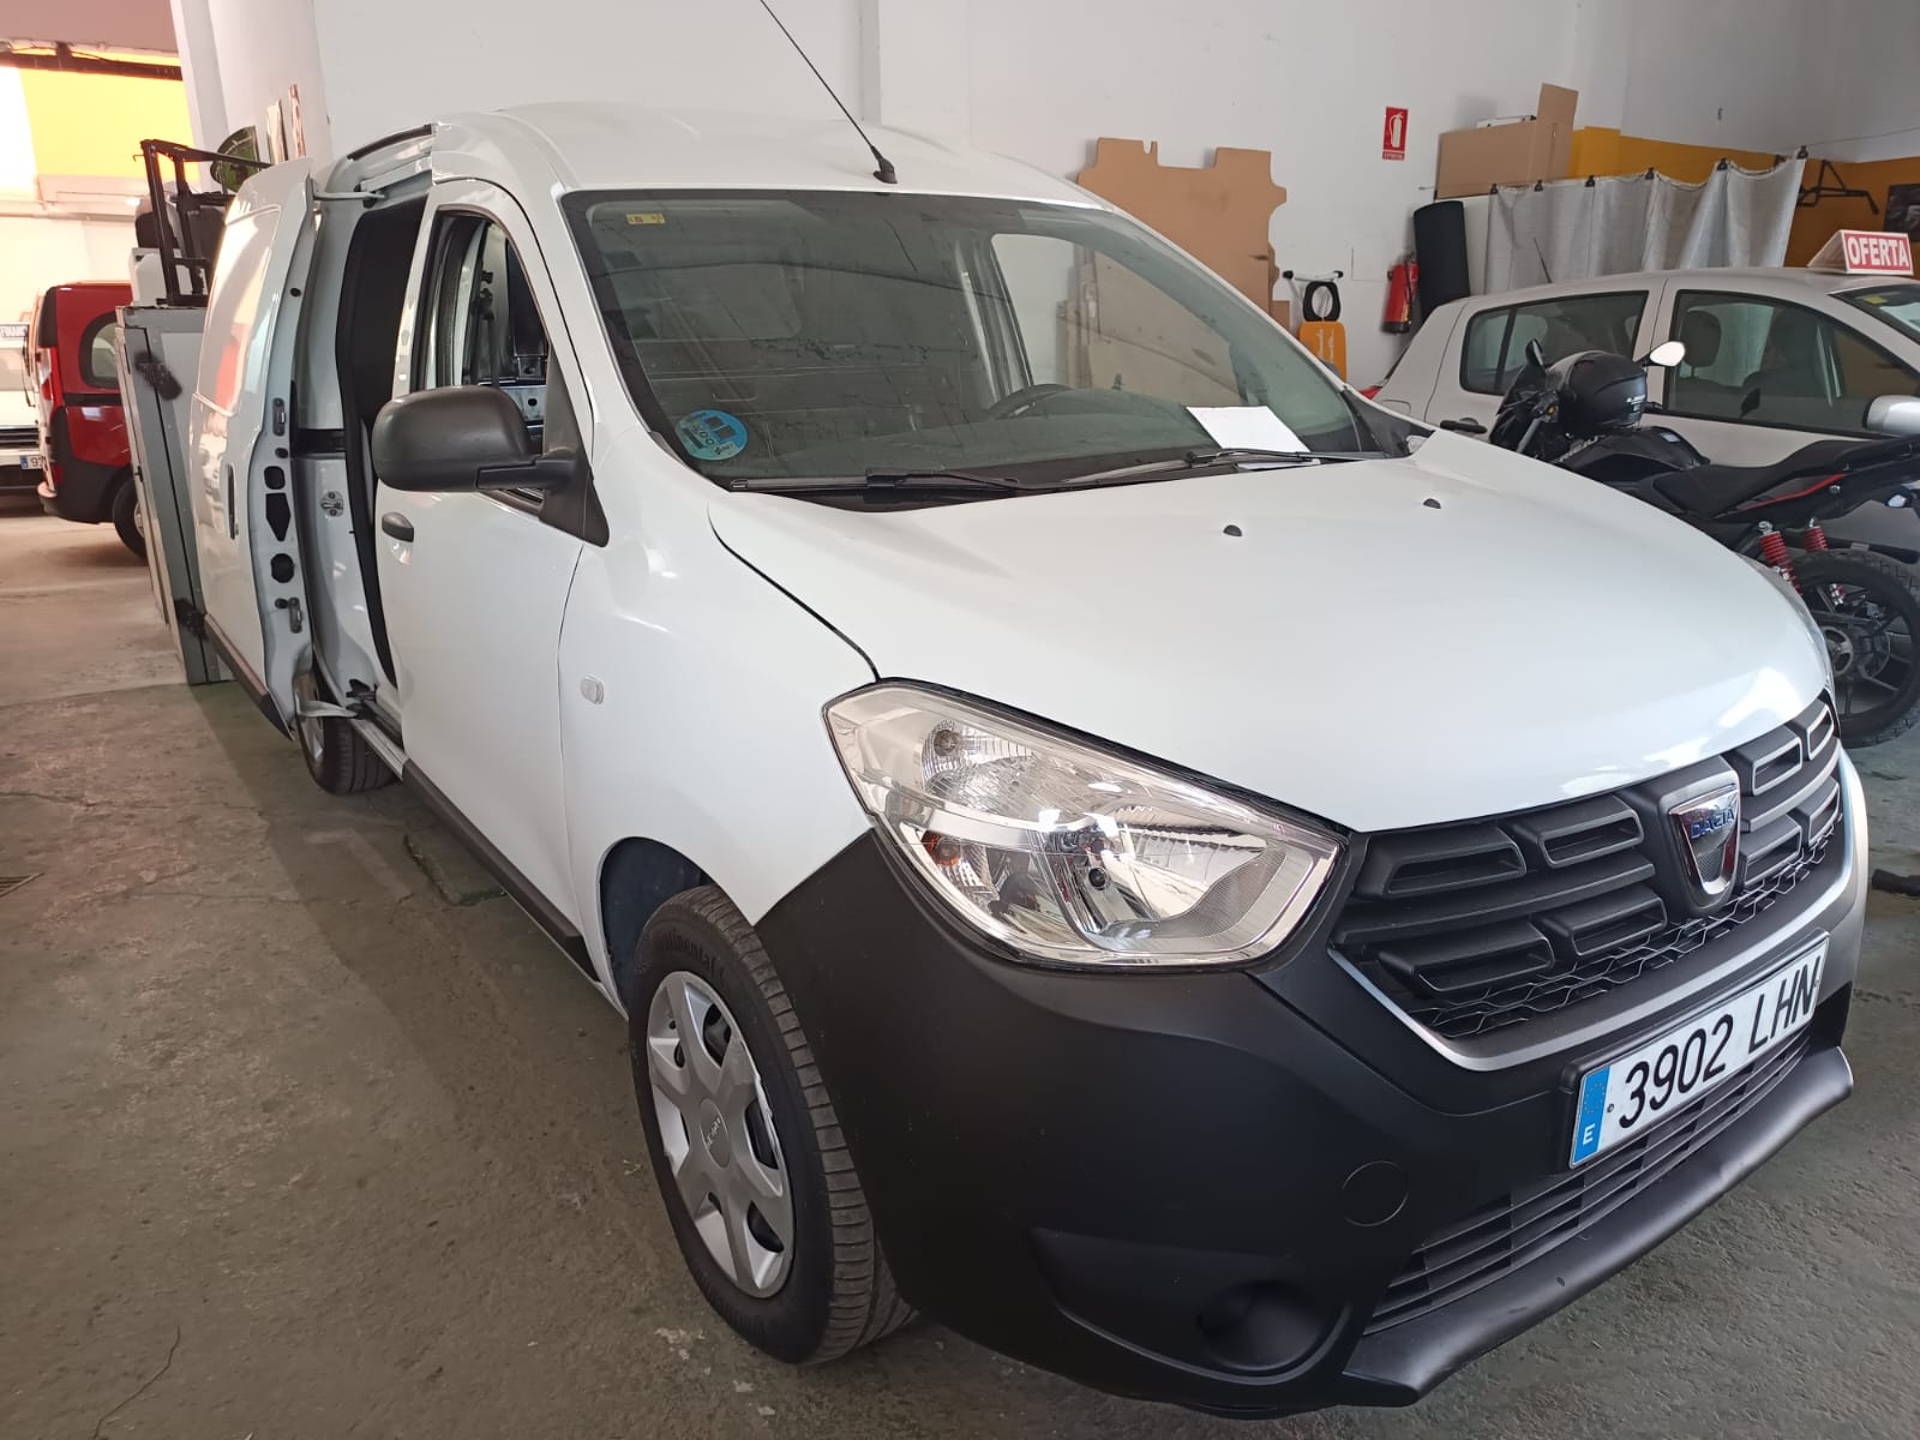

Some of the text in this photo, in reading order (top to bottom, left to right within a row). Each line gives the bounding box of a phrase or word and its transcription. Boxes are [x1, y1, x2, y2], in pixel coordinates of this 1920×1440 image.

[1847, 236, 1909, 267] OFERTA
[1691, 808, 1735, 839] DACIA
[1619, 955, 1821, 1128] 3902 LHN
[1582, 1122, 1596, 1146] E
